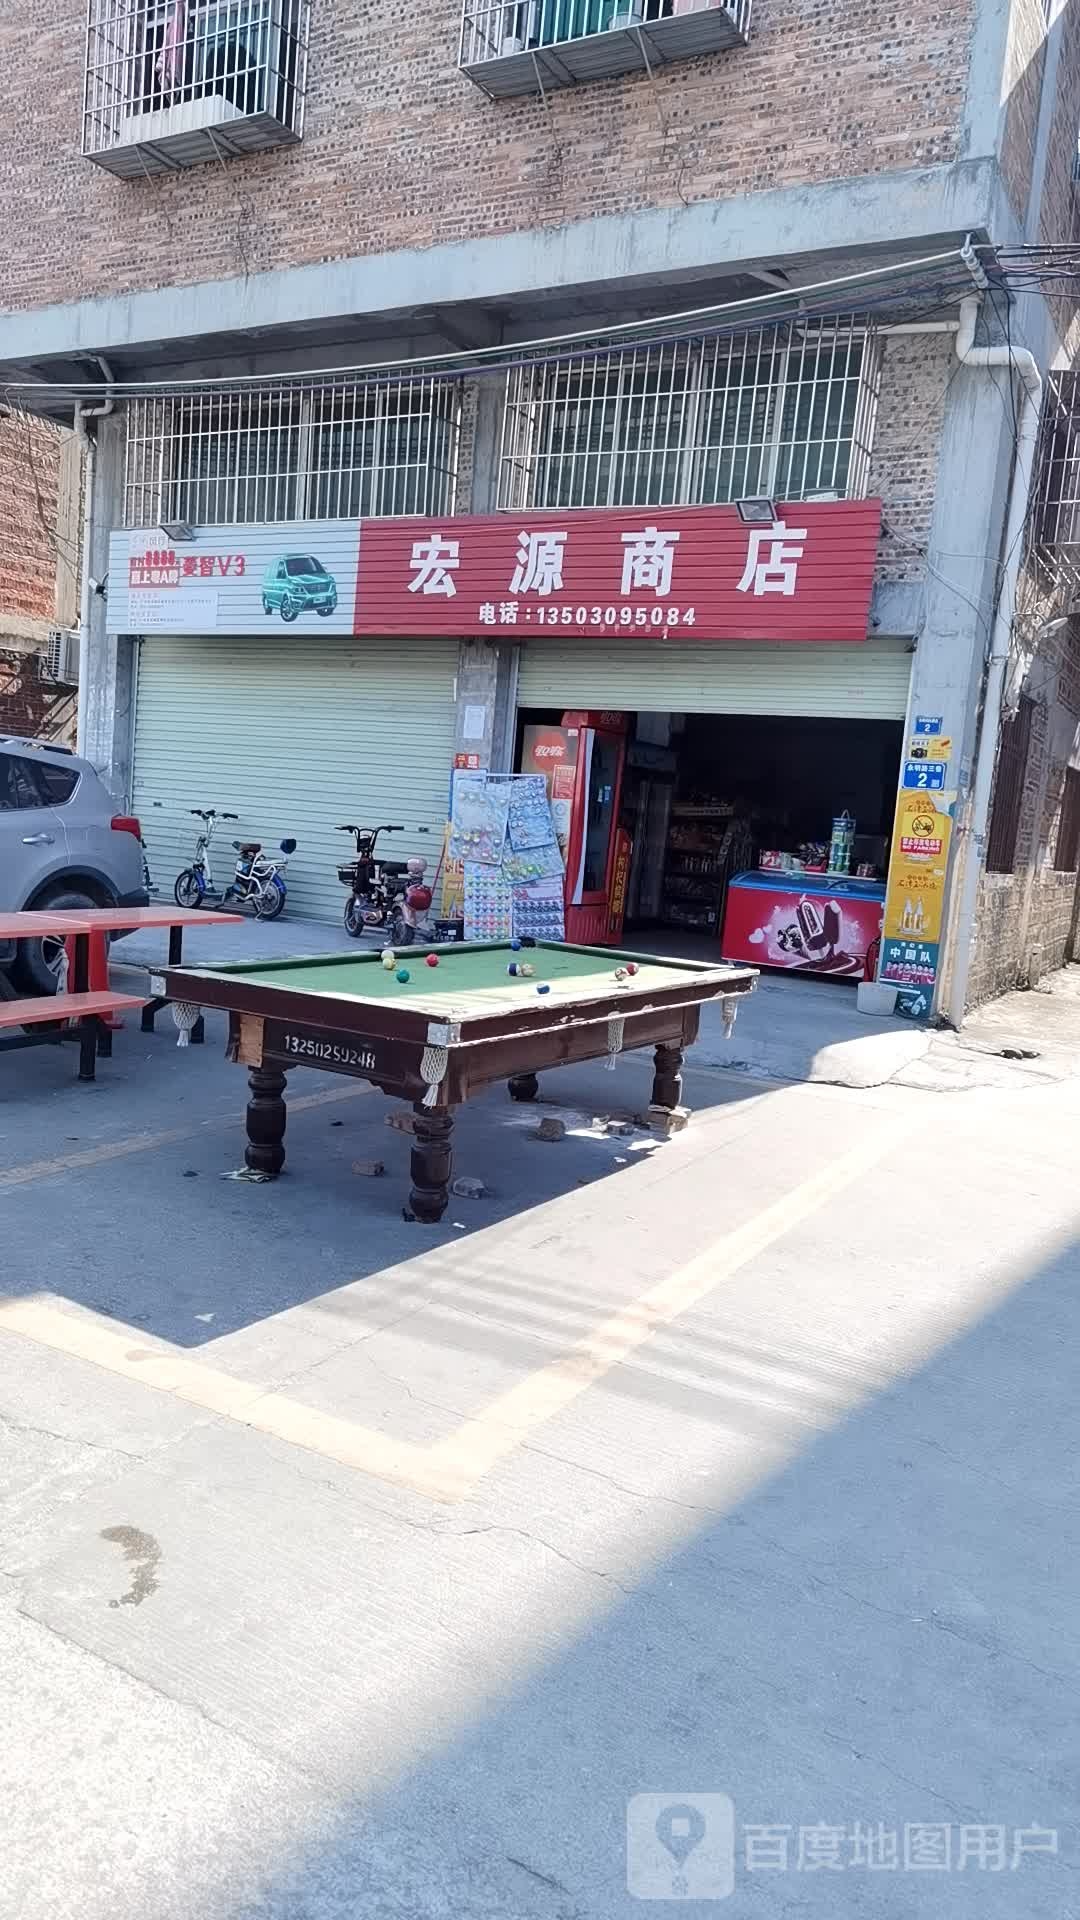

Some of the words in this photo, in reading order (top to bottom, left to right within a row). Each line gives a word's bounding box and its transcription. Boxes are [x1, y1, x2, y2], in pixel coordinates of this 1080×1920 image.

[407, 521, 807, 598] 宏源商店
[924, 723, 931, 732] 2
[917, 772, 928, 788] 2
[890, 947, 931, 963] 中国队
